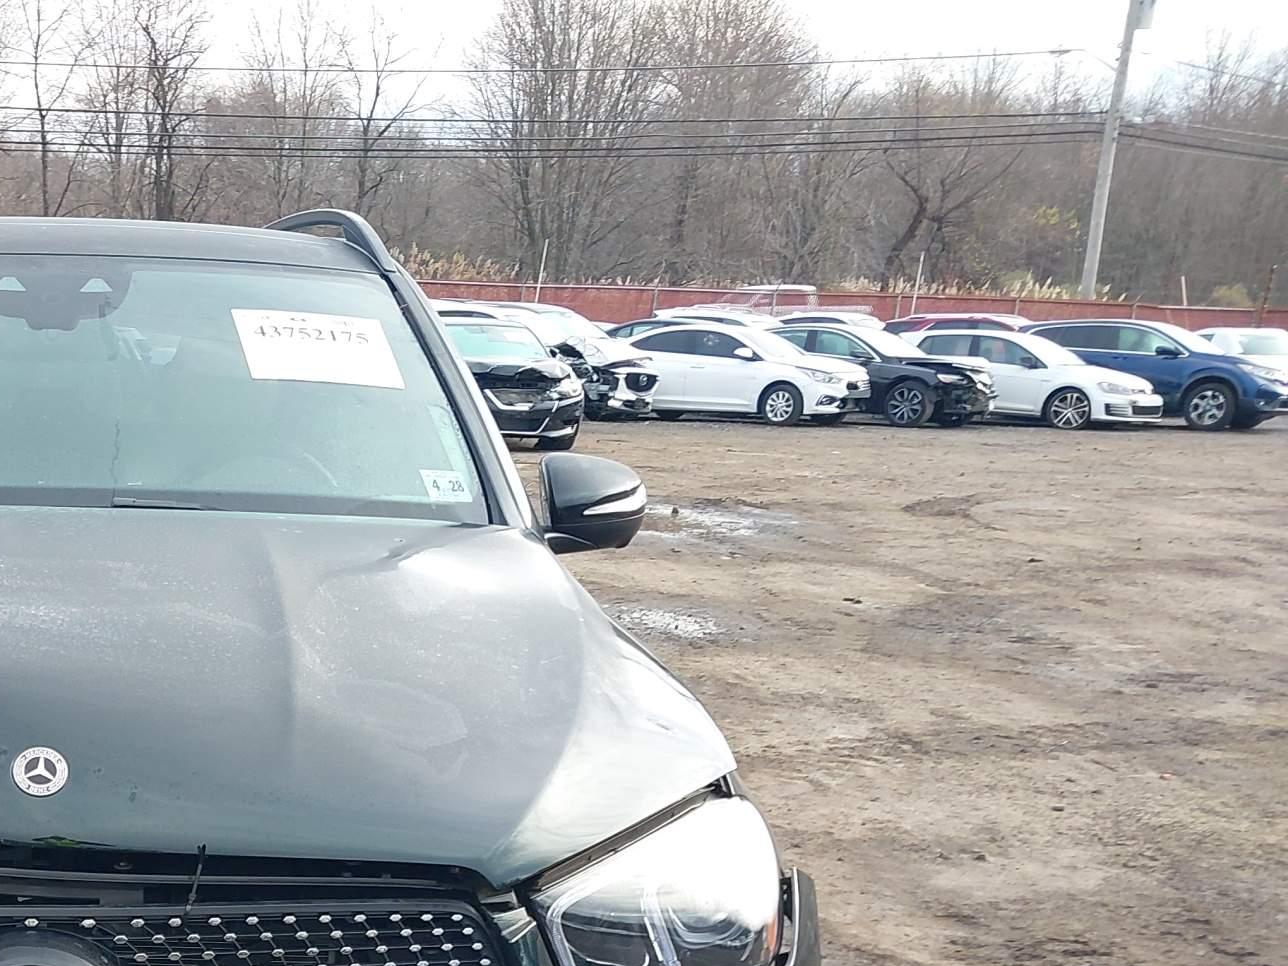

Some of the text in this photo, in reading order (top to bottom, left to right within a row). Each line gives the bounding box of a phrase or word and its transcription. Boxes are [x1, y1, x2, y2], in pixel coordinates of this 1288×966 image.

[254, 325, 369, 344] 43752175
[432, 479, 465, 492] 4 28
